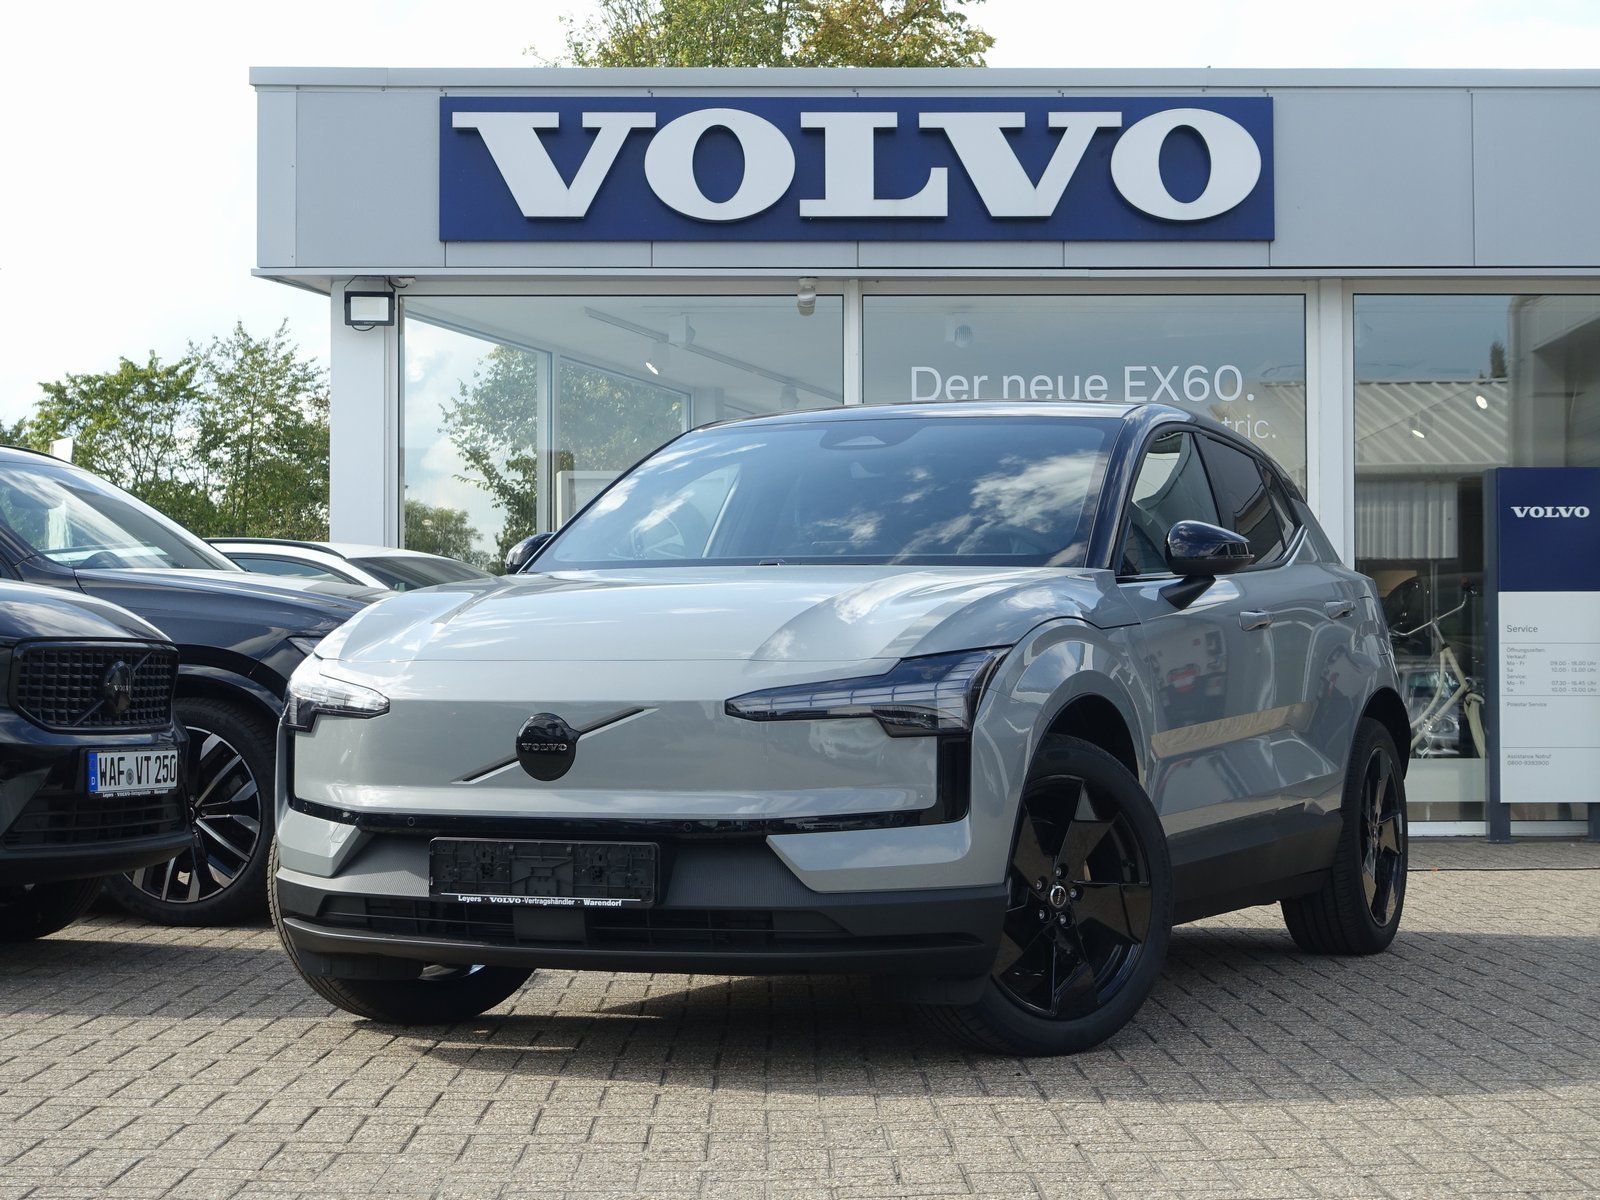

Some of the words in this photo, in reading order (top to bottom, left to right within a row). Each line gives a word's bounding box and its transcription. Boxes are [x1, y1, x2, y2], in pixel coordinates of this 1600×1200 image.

[452, 106, 1262, 221] VOLVO
[910, 366, 988, 400] Der
[1002, 374, 1108, 400] neue
[1124, 365, 1256, 401] EX60.
[1510, 506, 1590, 518] VOLVO
[1506, 624, 1539, 633] Service
[521, 742, 568, 751] VOLVO
[91, 776, 96, 786] D
[99, 756, 125, 787] WAF
[135, 755, 152, 785] VT
[154, 754, 177, 784] 250
[458, 895, 482, 903] Leyers
[583, 899, 622, 907] Warendorf
